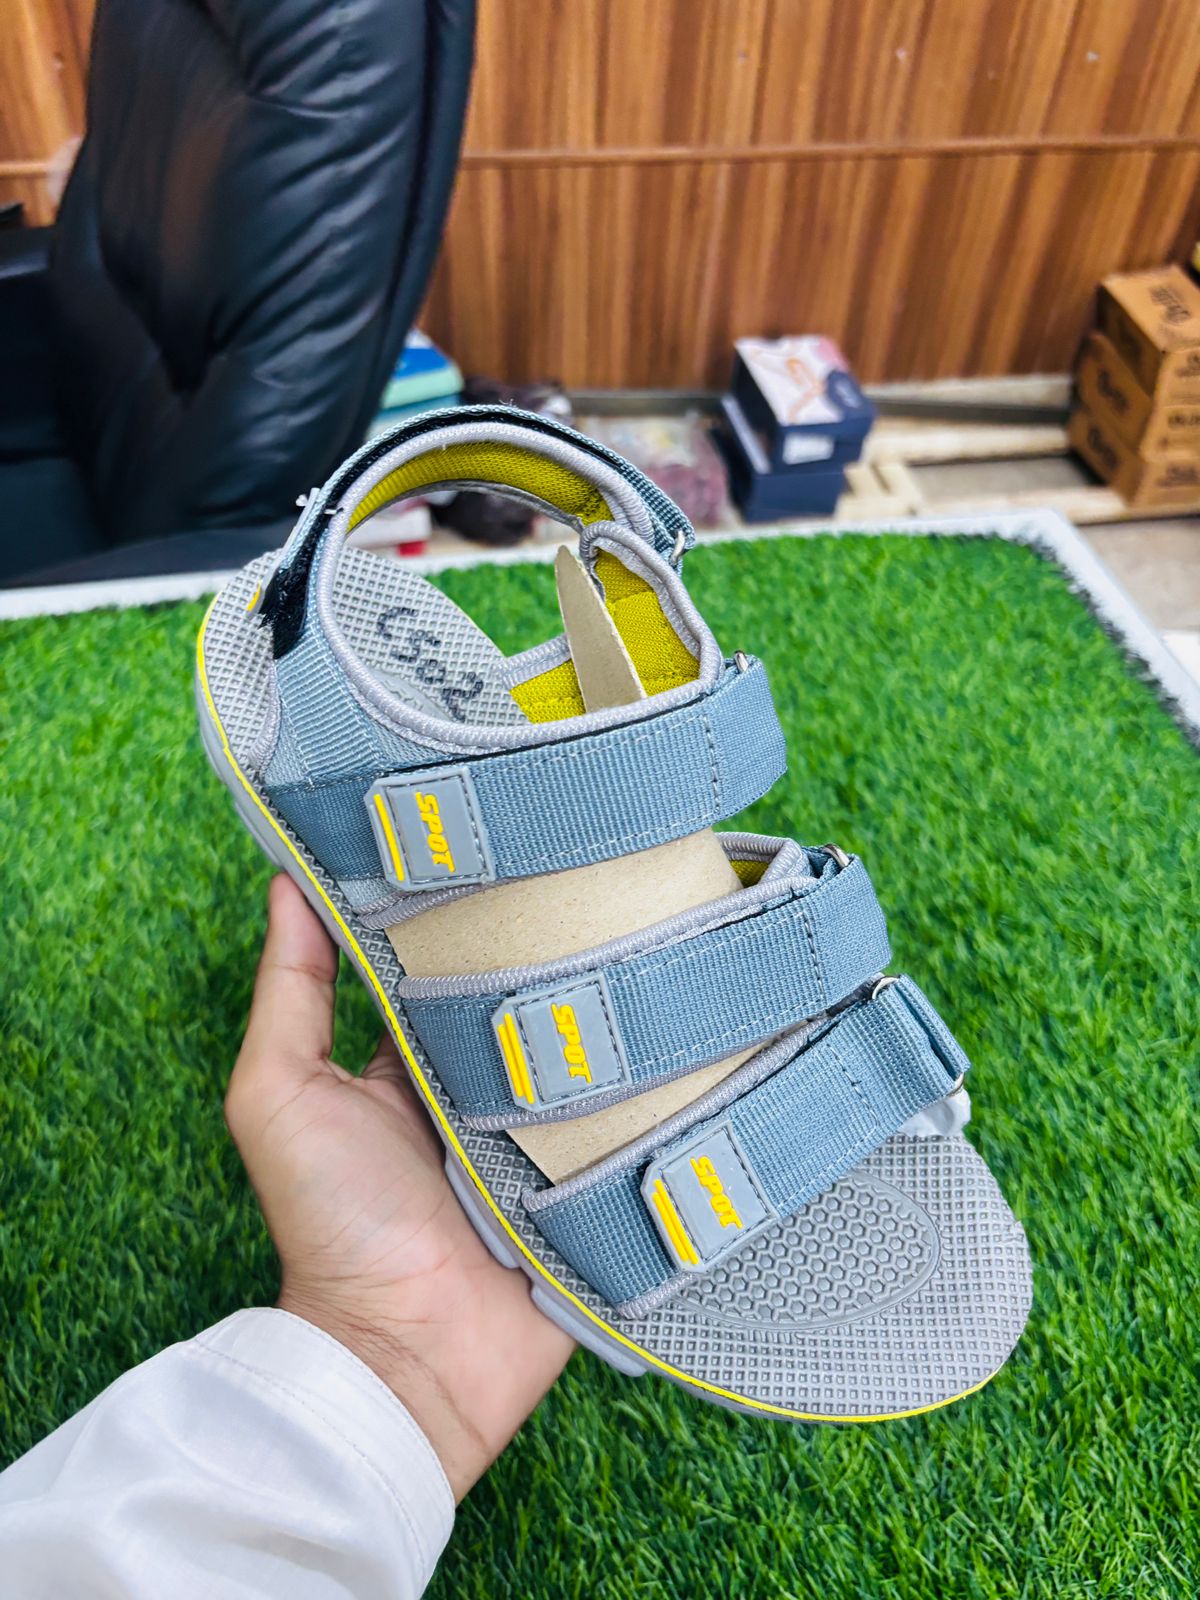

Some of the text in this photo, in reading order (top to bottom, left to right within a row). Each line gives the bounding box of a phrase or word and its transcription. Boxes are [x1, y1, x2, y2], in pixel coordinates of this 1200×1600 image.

[415, 791, 455, 873] SPOT
[551, 1003, 592, 1084] SPOT
[689, 1155, 743, 1230] SPOT
